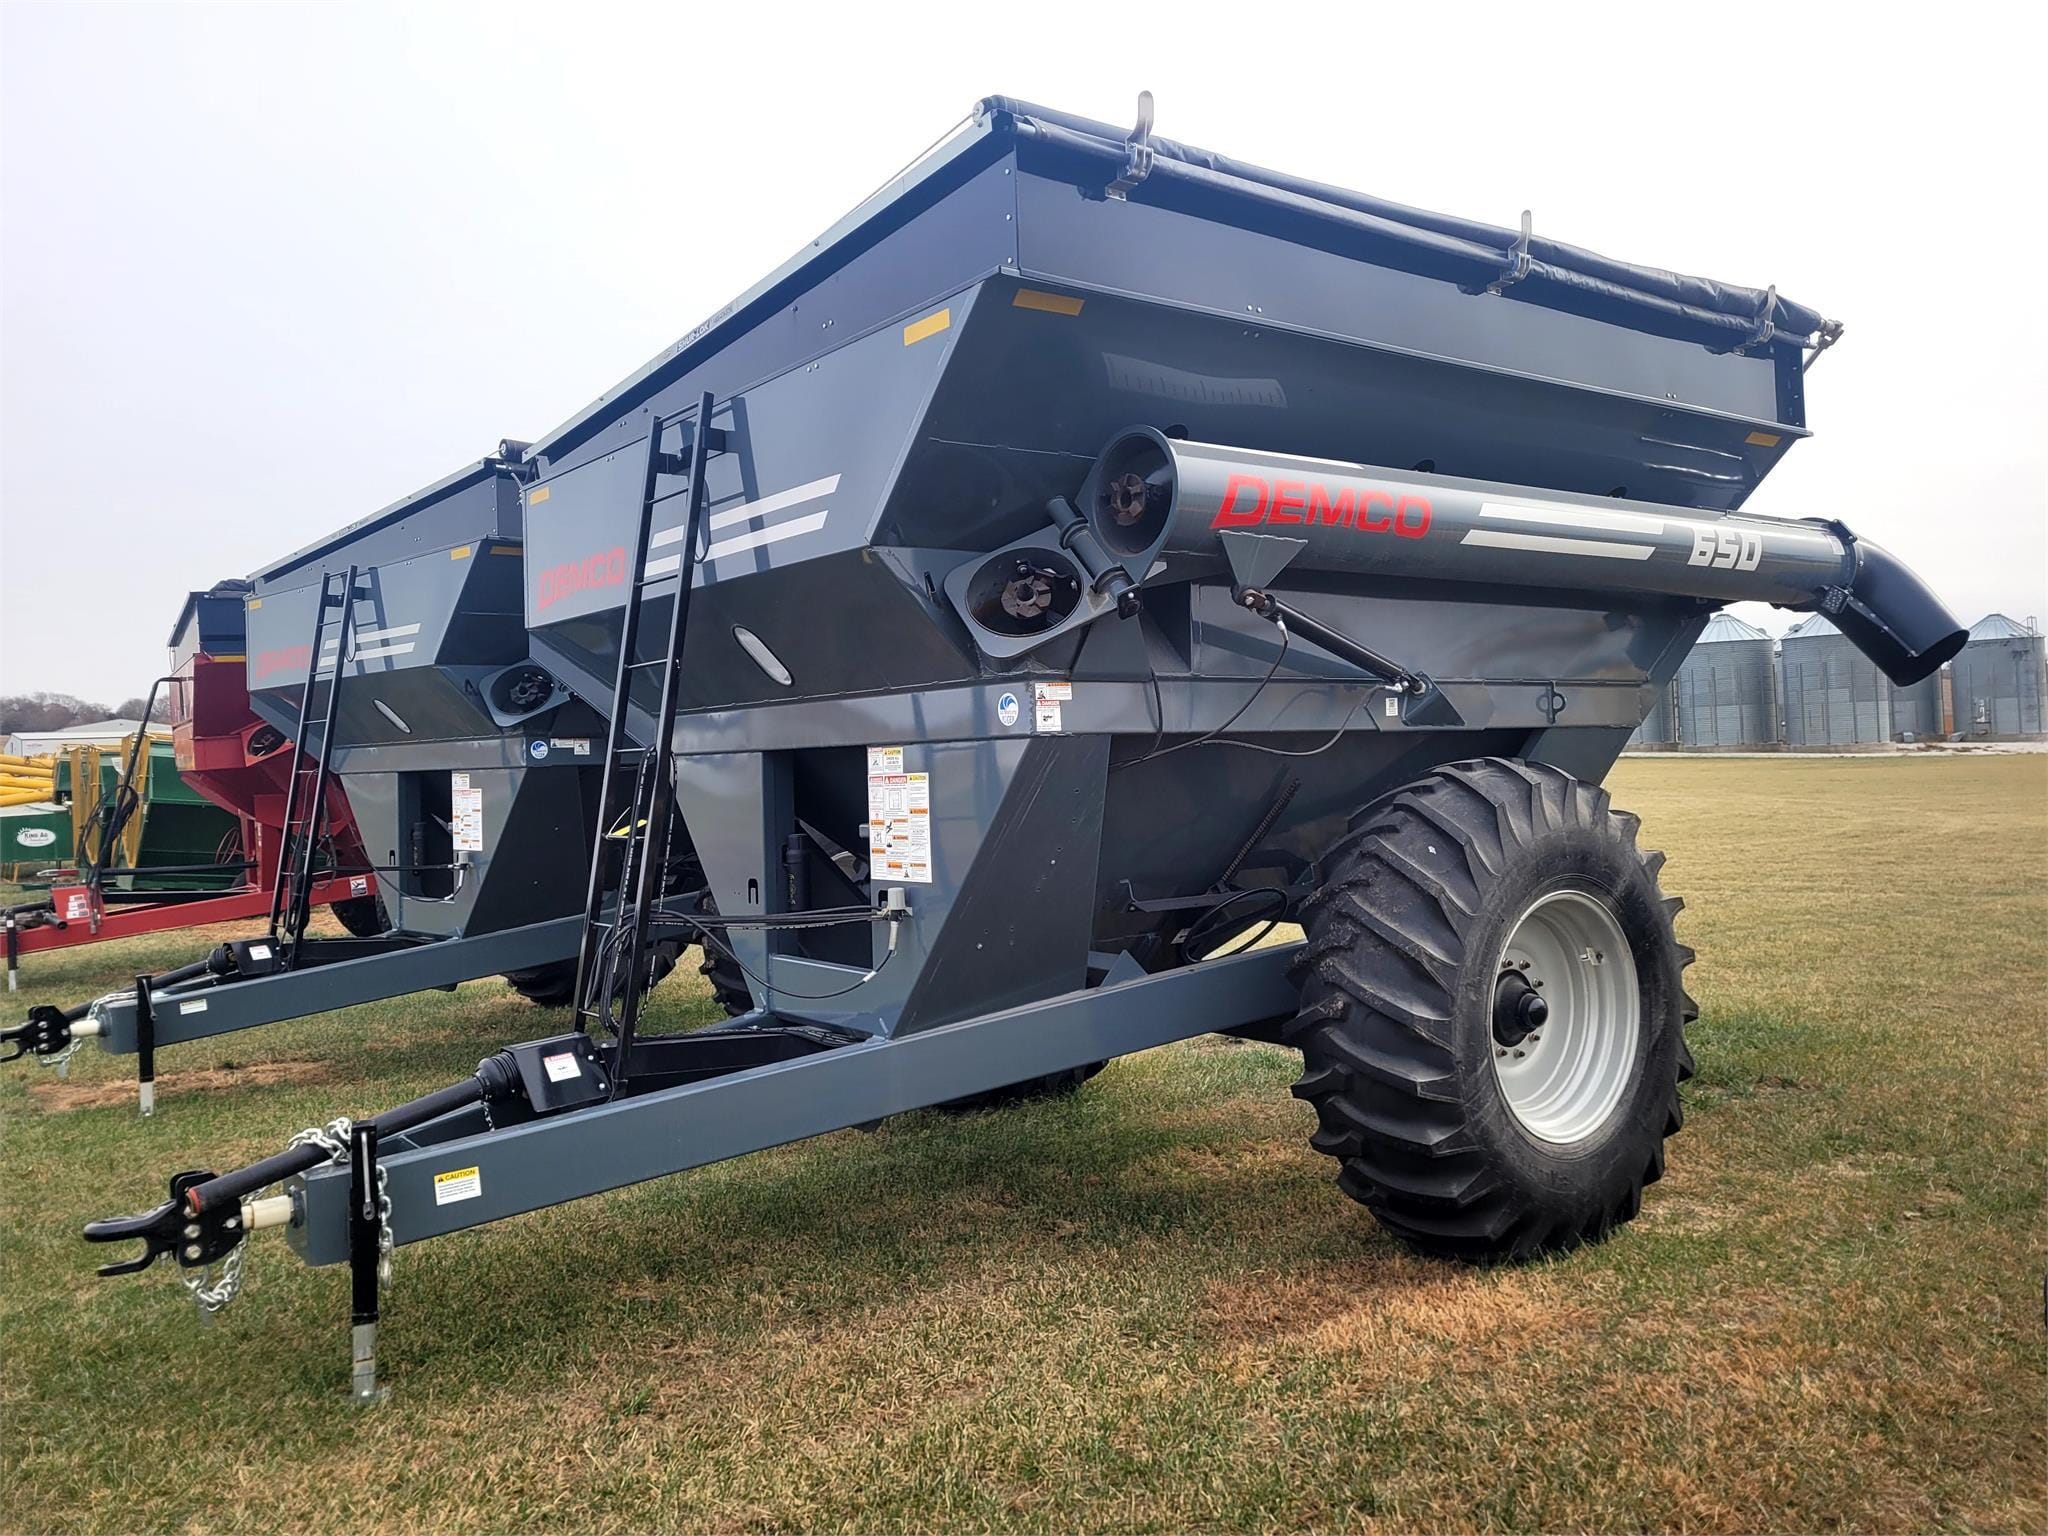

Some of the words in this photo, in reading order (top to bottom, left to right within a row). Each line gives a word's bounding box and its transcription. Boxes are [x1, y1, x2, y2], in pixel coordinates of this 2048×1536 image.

[1210, 473, 1432, 539] DEMCO
[1687, 526, 1762, 572] 650
[538, 546, 625, 611] DEMCO
[445, 1170, 476, 1180] CAUTION
